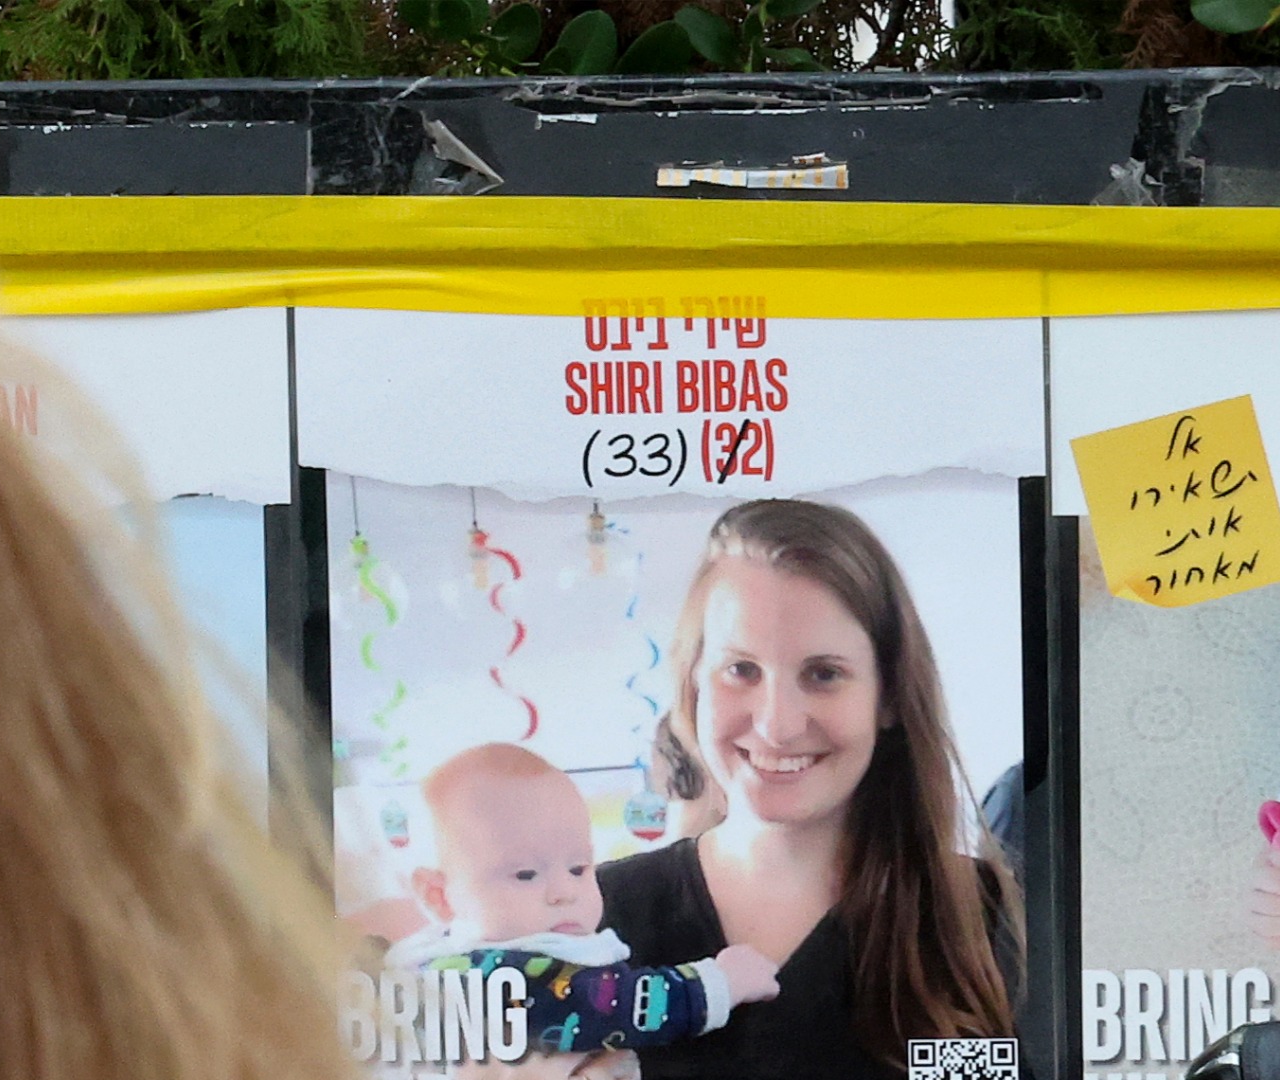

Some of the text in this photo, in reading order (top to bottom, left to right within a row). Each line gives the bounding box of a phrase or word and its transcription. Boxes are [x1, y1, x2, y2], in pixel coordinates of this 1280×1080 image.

[582, 296, 767, 352] שירי ביבס
[564, 358, 788, 415] SHIRI BIBAS
[582, 428, 688, 488] (33)
[701, 418, 774, 484] (32)
[1164, 415, 1202, 461] אל
[1145, 550, 1261, 597] מאחור
[338, 966, 528, 1063] BRING
[1082, 967, 1271, 1061] BRING
